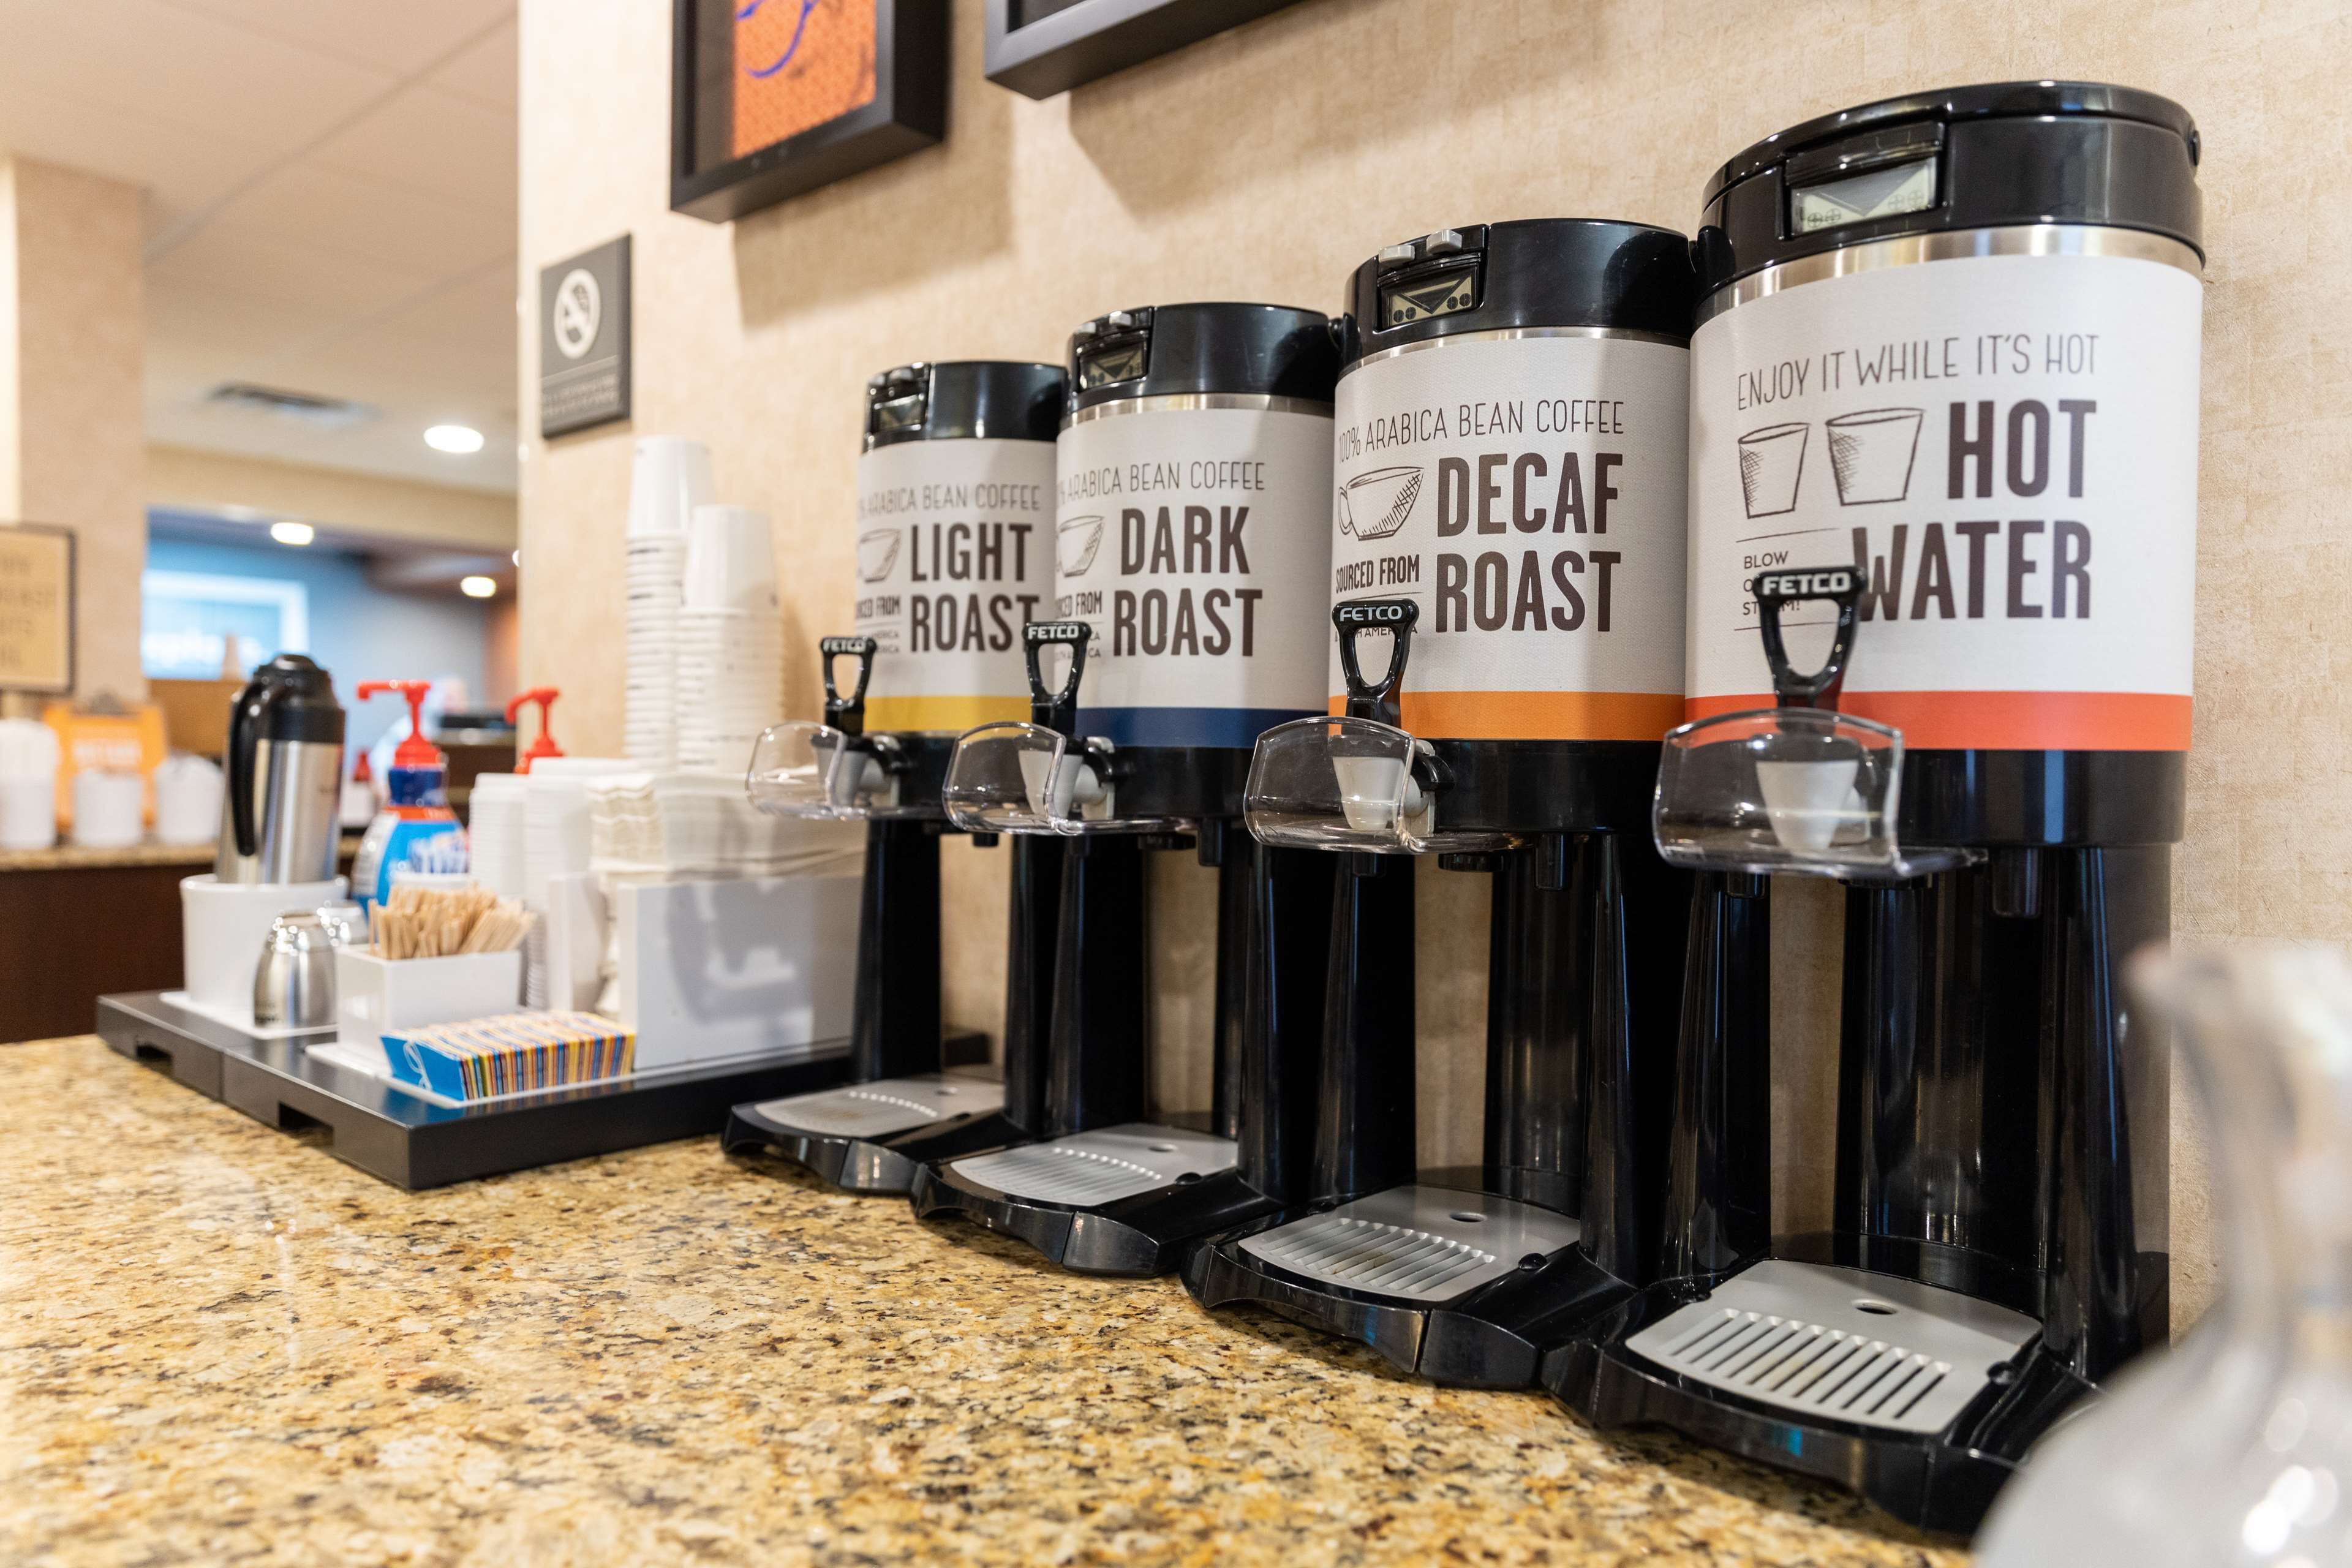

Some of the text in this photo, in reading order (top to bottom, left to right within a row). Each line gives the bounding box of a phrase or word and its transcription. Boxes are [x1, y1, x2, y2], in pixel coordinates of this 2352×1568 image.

[1737, 358, 1809, 410] ENJOY
[1822, 351, 1845, 392] IT
[1855, 337, 1959, 385] WHILE
[2046, 334, 2099, 375] HOT
[1339, 400, 1624, 464] 100% ARABICA BEAN COFFEE
[1947, 399, 2097, 499] HOT
[922, 483, 968, 510] BEAN
[975, 483, 1041, 511] COFFEE
[1068, 466, 1122, 502] ARABICA
[1130, 462, 1180, 492] BEAN
[1191, 461, 1265, 490] COFFEE
[1438, 452, 1623, 537] DECAF
[911, 522, 1033, 582] LIGHT
[1121, 505, 1250, 575] DARK
[1744, 551, 1789, 569] BLOW
[1336, 554, 1420, 594] SOURCED FROM
[1436, 550, 1621, 633] ROAST
[1762, 572, 1851, 595] FETCO
[1852, 520, 2092, 621] WATER
[911, 594, 1039, 652] ROAST
[1028, 625, 1079, 639] FETCO
[1076, 590, 1102, 616] FROM
[1114, 588, 1262, 657] ROAST
[1340, 606, 1403, 622] FETCO
[1743, 600, 1800, 616] STM!
